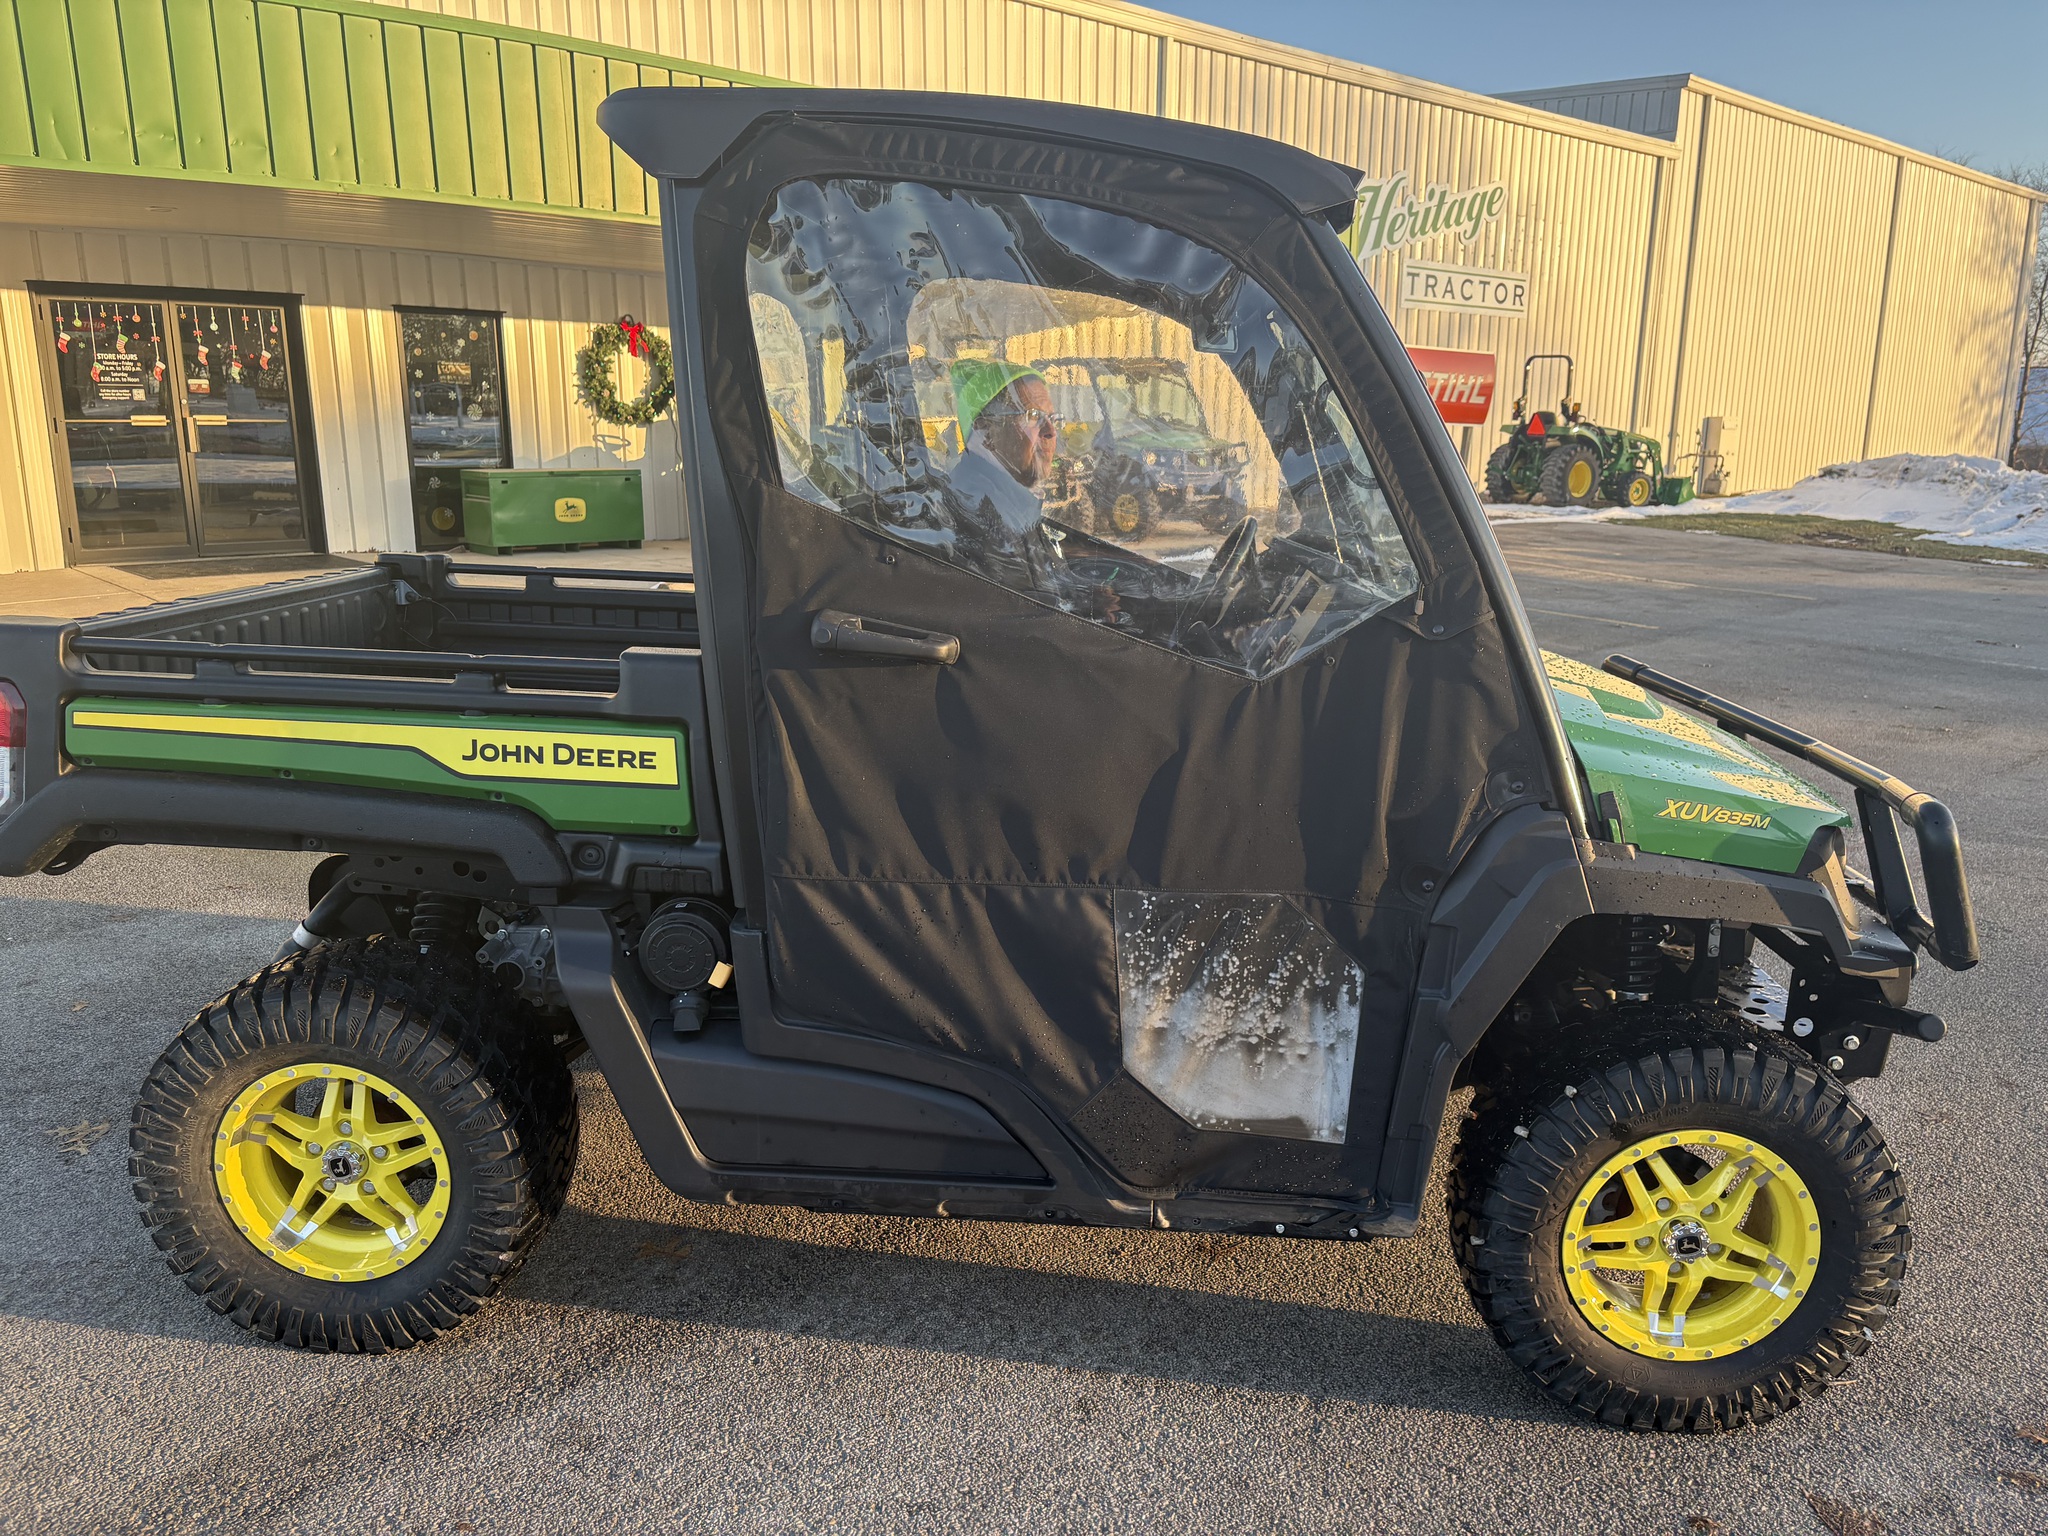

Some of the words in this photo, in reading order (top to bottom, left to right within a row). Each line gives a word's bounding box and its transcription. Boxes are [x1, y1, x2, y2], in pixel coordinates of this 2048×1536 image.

[1358, 176, 1504, 251] Heritage
[1406, 271, 1526, 307] TRACTOR
[462, 739, 544, 765] JOHN
[553, 743, 657, 770] DEERE
[1657, 799, 1773, 830] XUV835M
